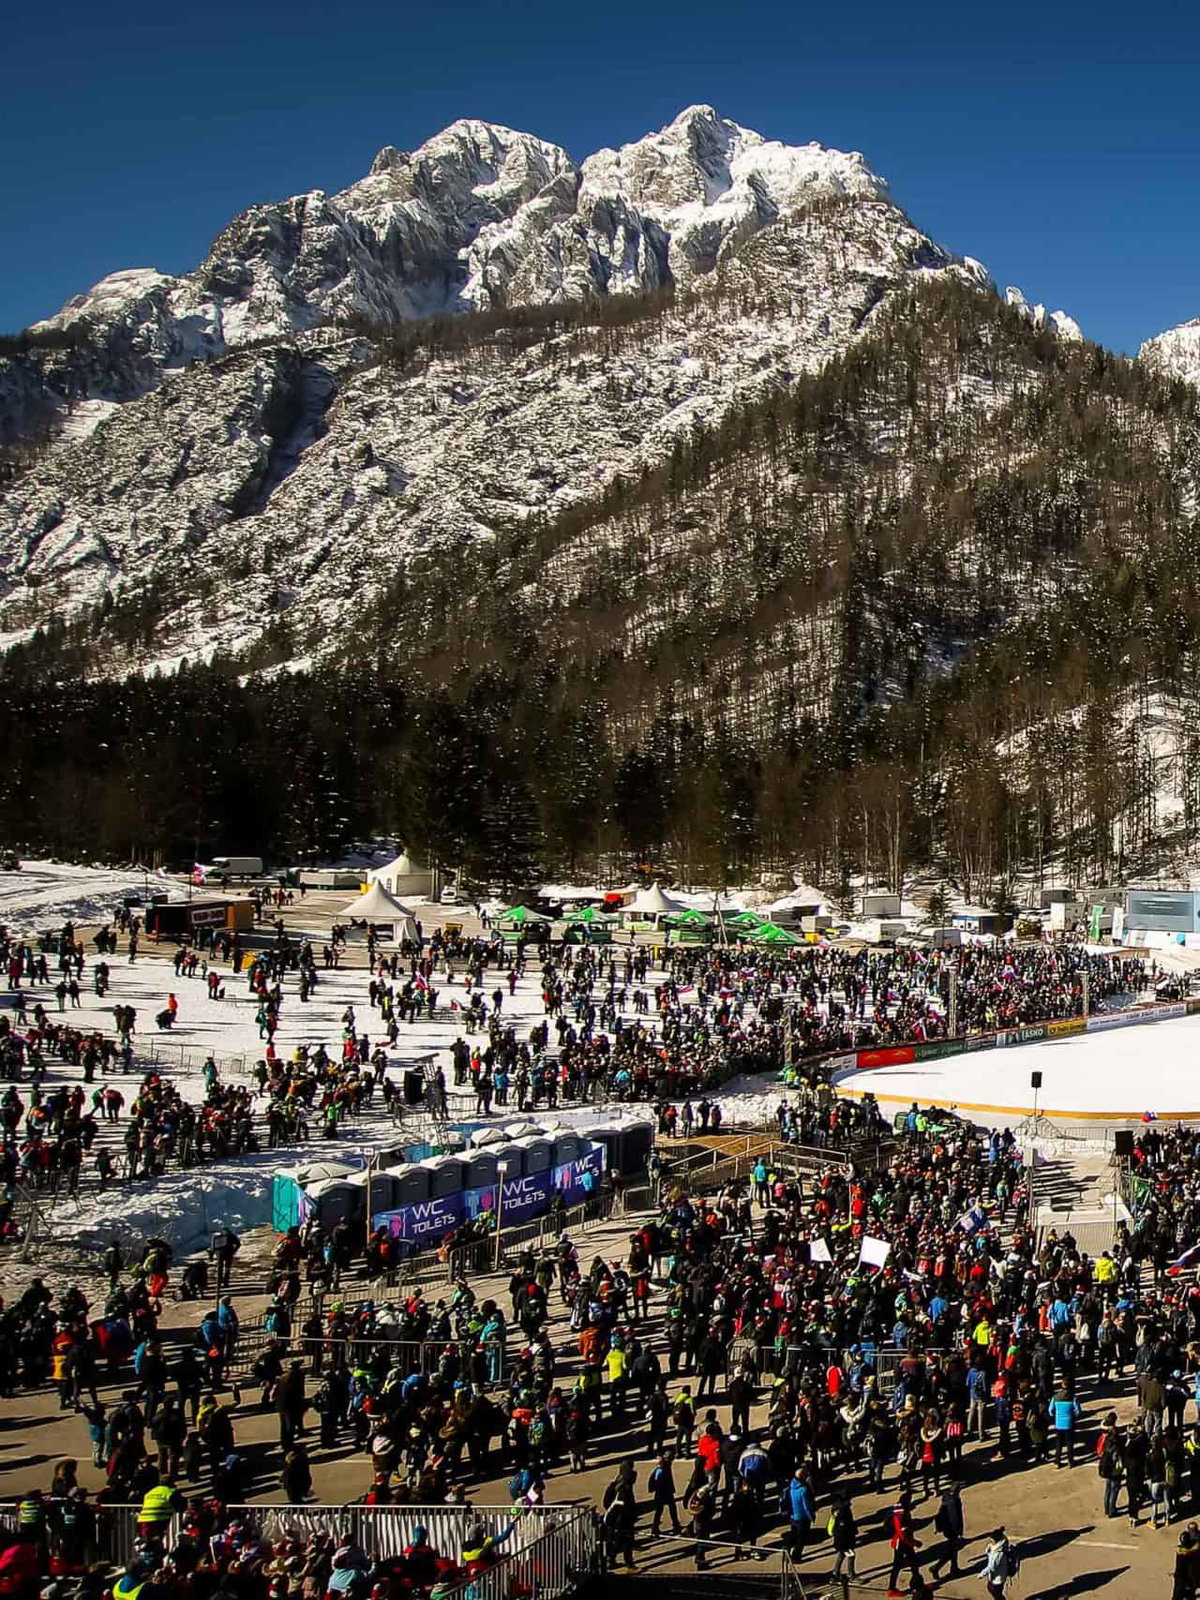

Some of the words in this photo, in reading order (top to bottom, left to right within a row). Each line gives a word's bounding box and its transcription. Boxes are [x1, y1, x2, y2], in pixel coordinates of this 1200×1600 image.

[575, 1154, 594, 1174] WC
[502, 1176, 536, 1197] WC
[412, 1199, 445, 1220] WC
[502, 1190, 546, 1211] TOILETS
[412, 1213, 456, 1234] TOILETS
